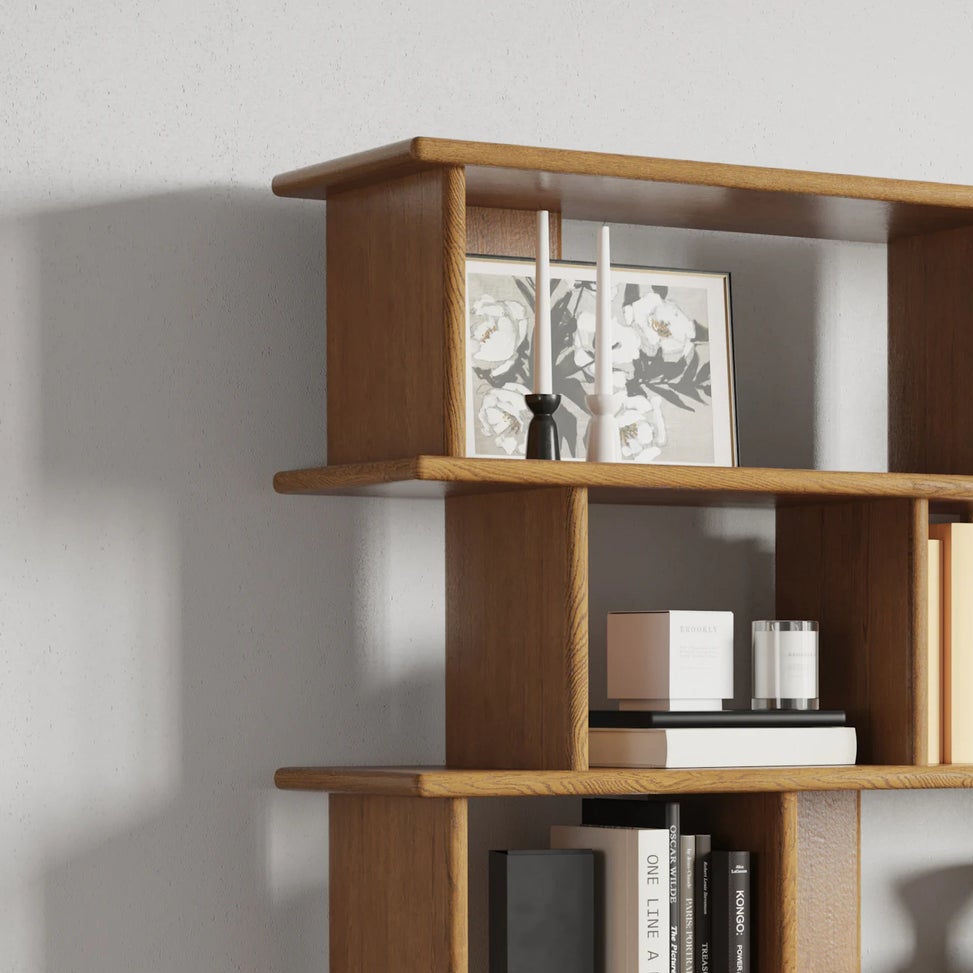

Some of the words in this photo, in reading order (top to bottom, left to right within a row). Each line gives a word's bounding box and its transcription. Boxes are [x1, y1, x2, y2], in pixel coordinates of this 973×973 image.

[646, 854, 660, 885] ONE
[646, 898, 660, 938] LINE
[736, 890, 745, 936] KONGO:
[646, 950, 660, 961] A
